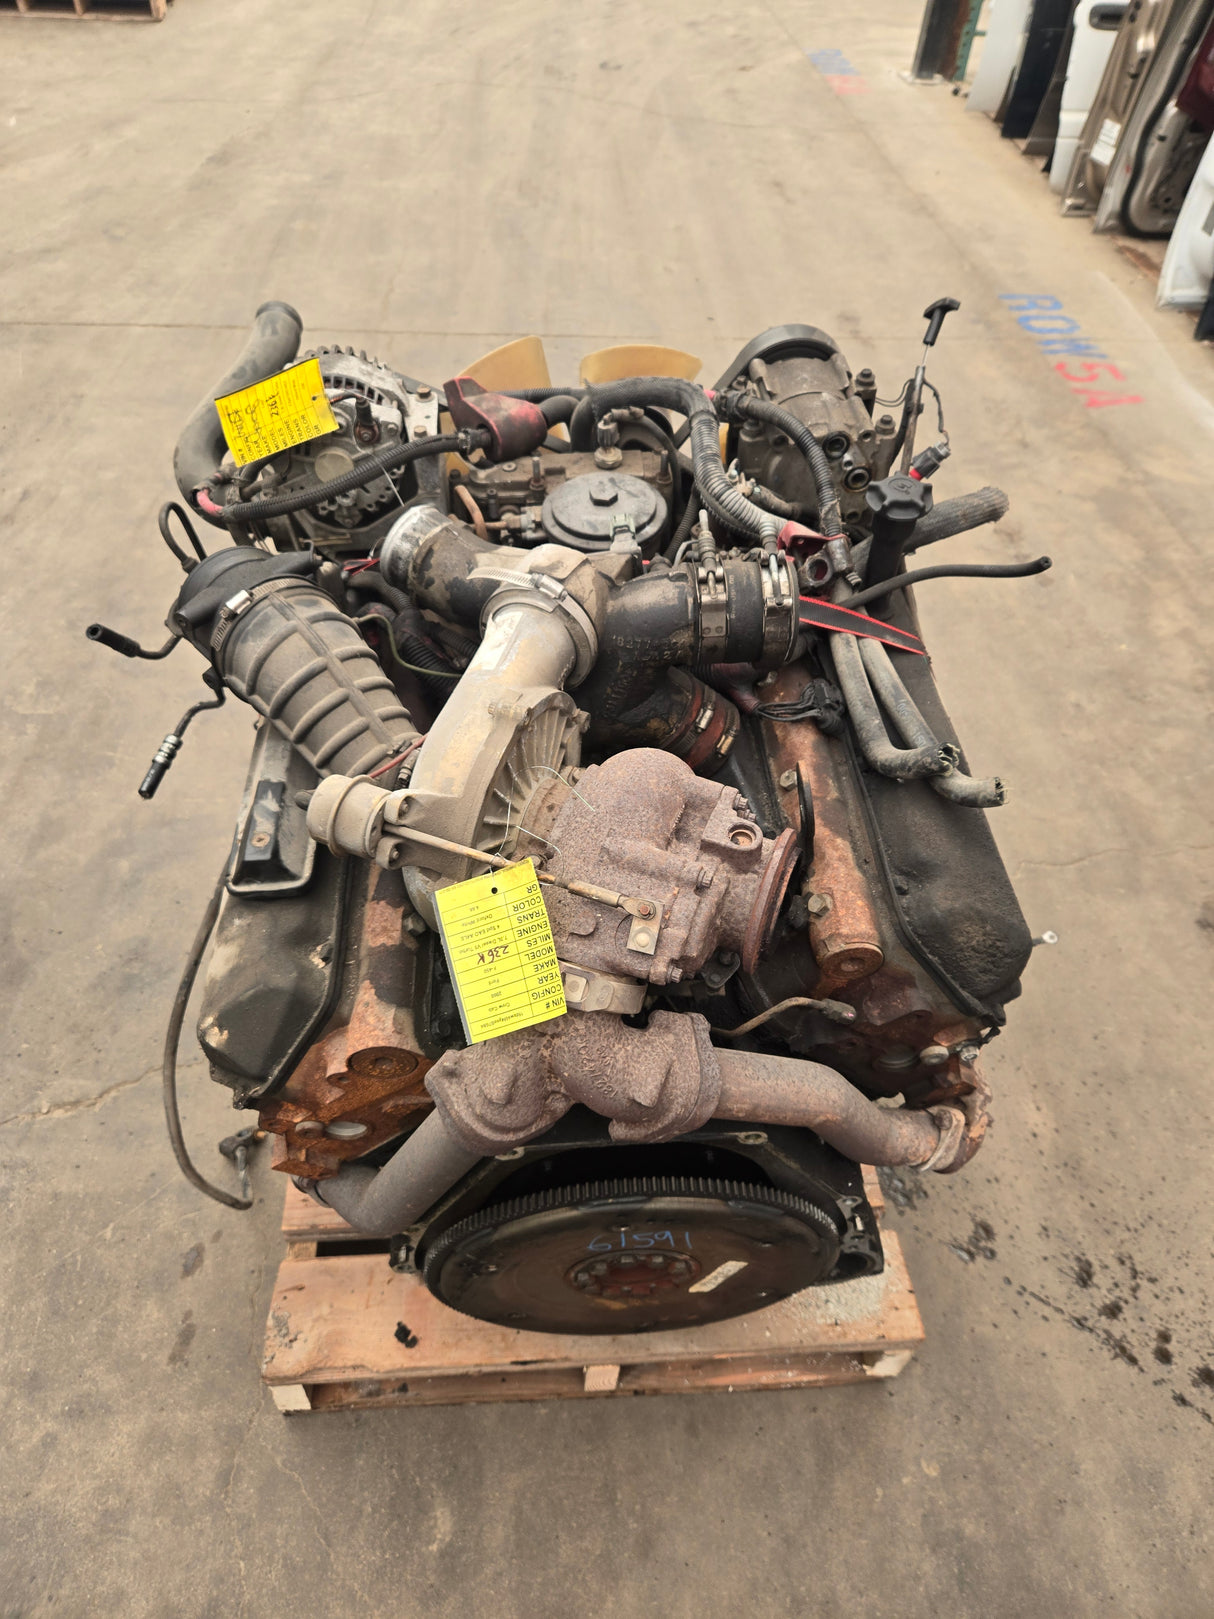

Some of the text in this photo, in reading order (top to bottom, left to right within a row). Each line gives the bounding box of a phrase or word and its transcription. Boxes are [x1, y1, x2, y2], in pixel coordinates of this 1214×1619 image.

[998, 294, 1108, 359] ROW
[300, 413, 313, 438] COLOR
[268, 427, 279, 451] MODEL
[525, 883, 537, 894] GR
[512, 895, 541, 912] COLOR
[516, 908, 544, 923] TRANS
[516, 920, 547, 937] ENGINE
[526, 932, 550, 947] MILES
[524, 945, 553, 961] MODEL
[532, 958, 556, 972] MAKE
[537, 970, 559, 984] YEAR
[531, 983, 561, 1000] CONFIG
[544, 996, 564, 1009] VIN #
